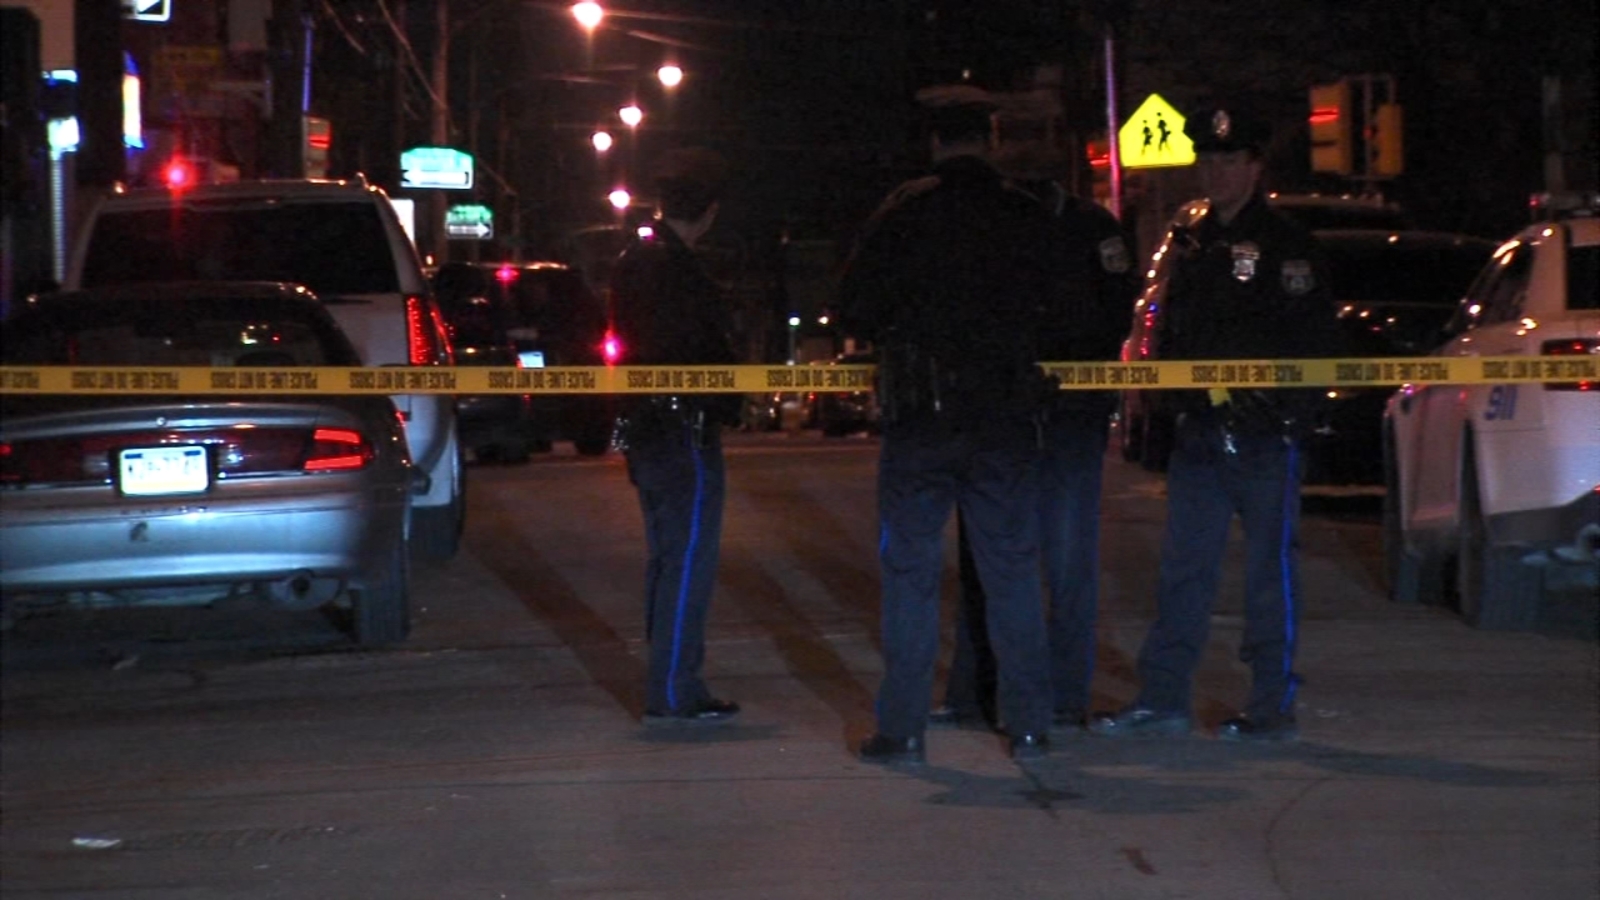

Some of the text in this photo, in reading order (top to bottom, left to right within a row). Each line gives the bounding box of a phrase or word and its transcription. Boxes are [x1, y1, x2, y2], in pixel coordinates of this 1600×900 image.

[1078, 368, 1092, 385] NOT
[1094, 368, 1106, 384] DO
[1108, 367, 1128, 384] LINE
[1130, 366, 1158, 383] POLICE
[1192, 363, 1301, 382] POLICE LINE DO NOT CROSS
[1336, 361, 1446, 379] POLICE LINE DO NOT CROSS
[1482, 360, 1597, 378] POLICE LINE DO NOT CROSS
[12, 372, 39, 388] POLICE
[70, 372, 178, 388] POLICE LINE DO NOT CROSS
[210, 371, 316, 388] POLICE LINE DO NOT CROSS
[350, 371, 456, 388] POLICE LINE DO NOT CROSS
[488, 371, 594, 388] POLICE LINE DO NOT CROSS
[627, 370, 734, 387] POLICE LINE DO NOT CROSS
[766, 370, 792, 387] CROSS
[794, 370, 808, 387] NOT
[812, 370, 822, 387] DO
[824, 370, 844, 387] LINE
[1484, 384, 1518, 420] 911
